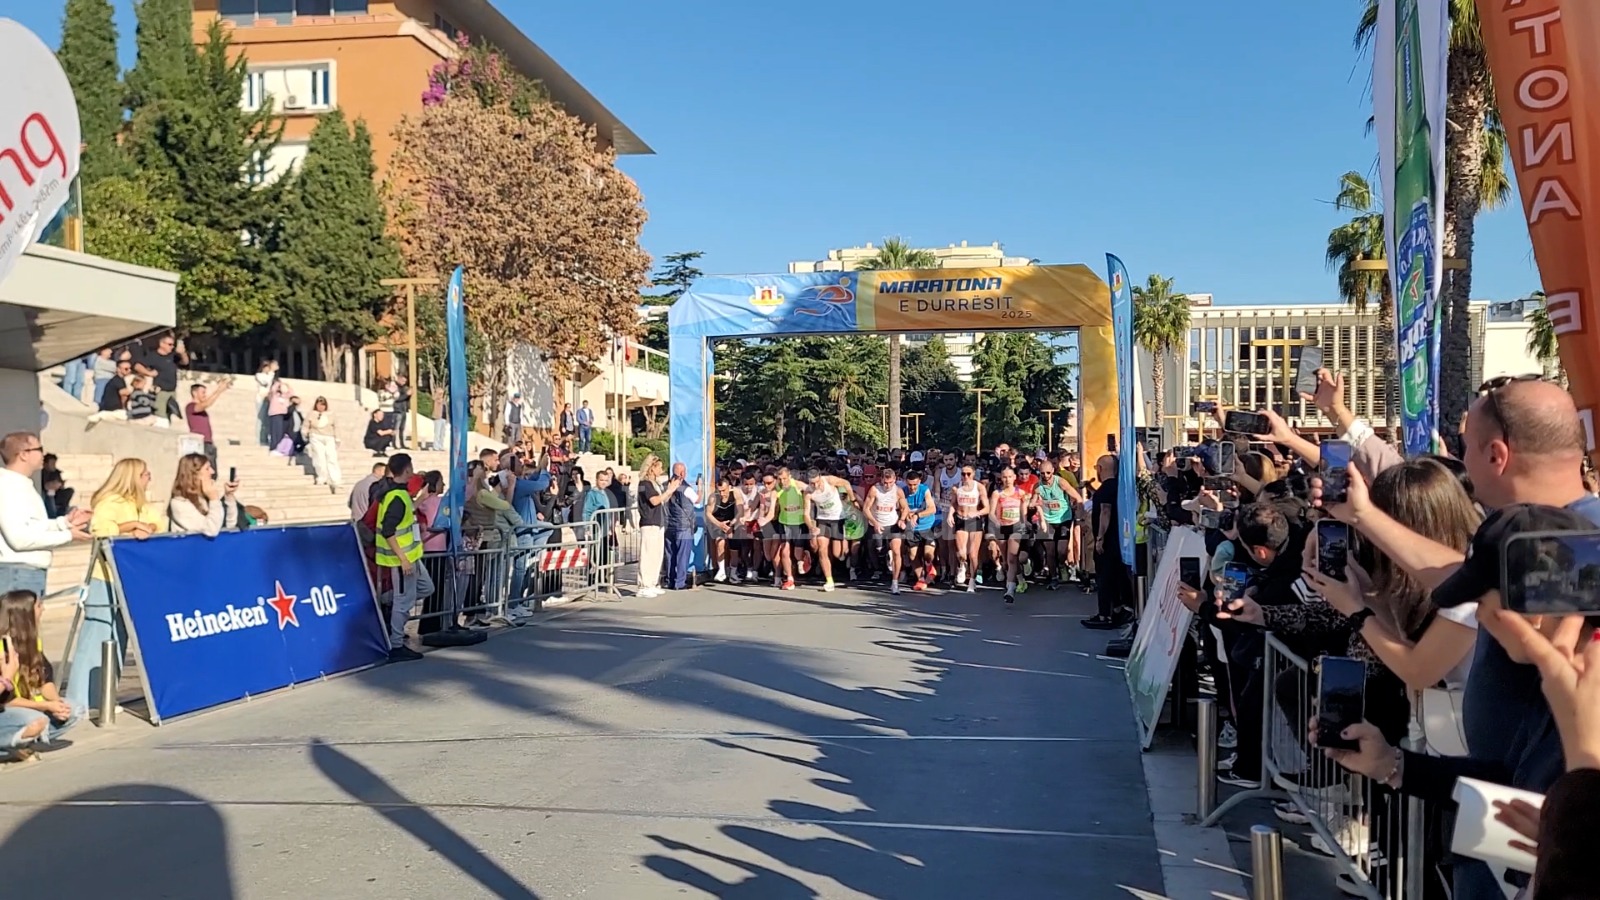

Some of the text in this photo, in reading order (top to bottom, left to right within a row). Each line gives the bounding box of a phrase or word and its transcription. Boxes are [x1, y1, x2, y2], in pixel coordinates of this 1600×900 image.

[0, 112, 67, 224] ng
[879, 277, 1002, 294] MARATONA
[900, 295, 1013, 312] E DURRËSIT
[1001, 310, 1032, 319] 2025
[165, 602, 269, 642] Heineken
